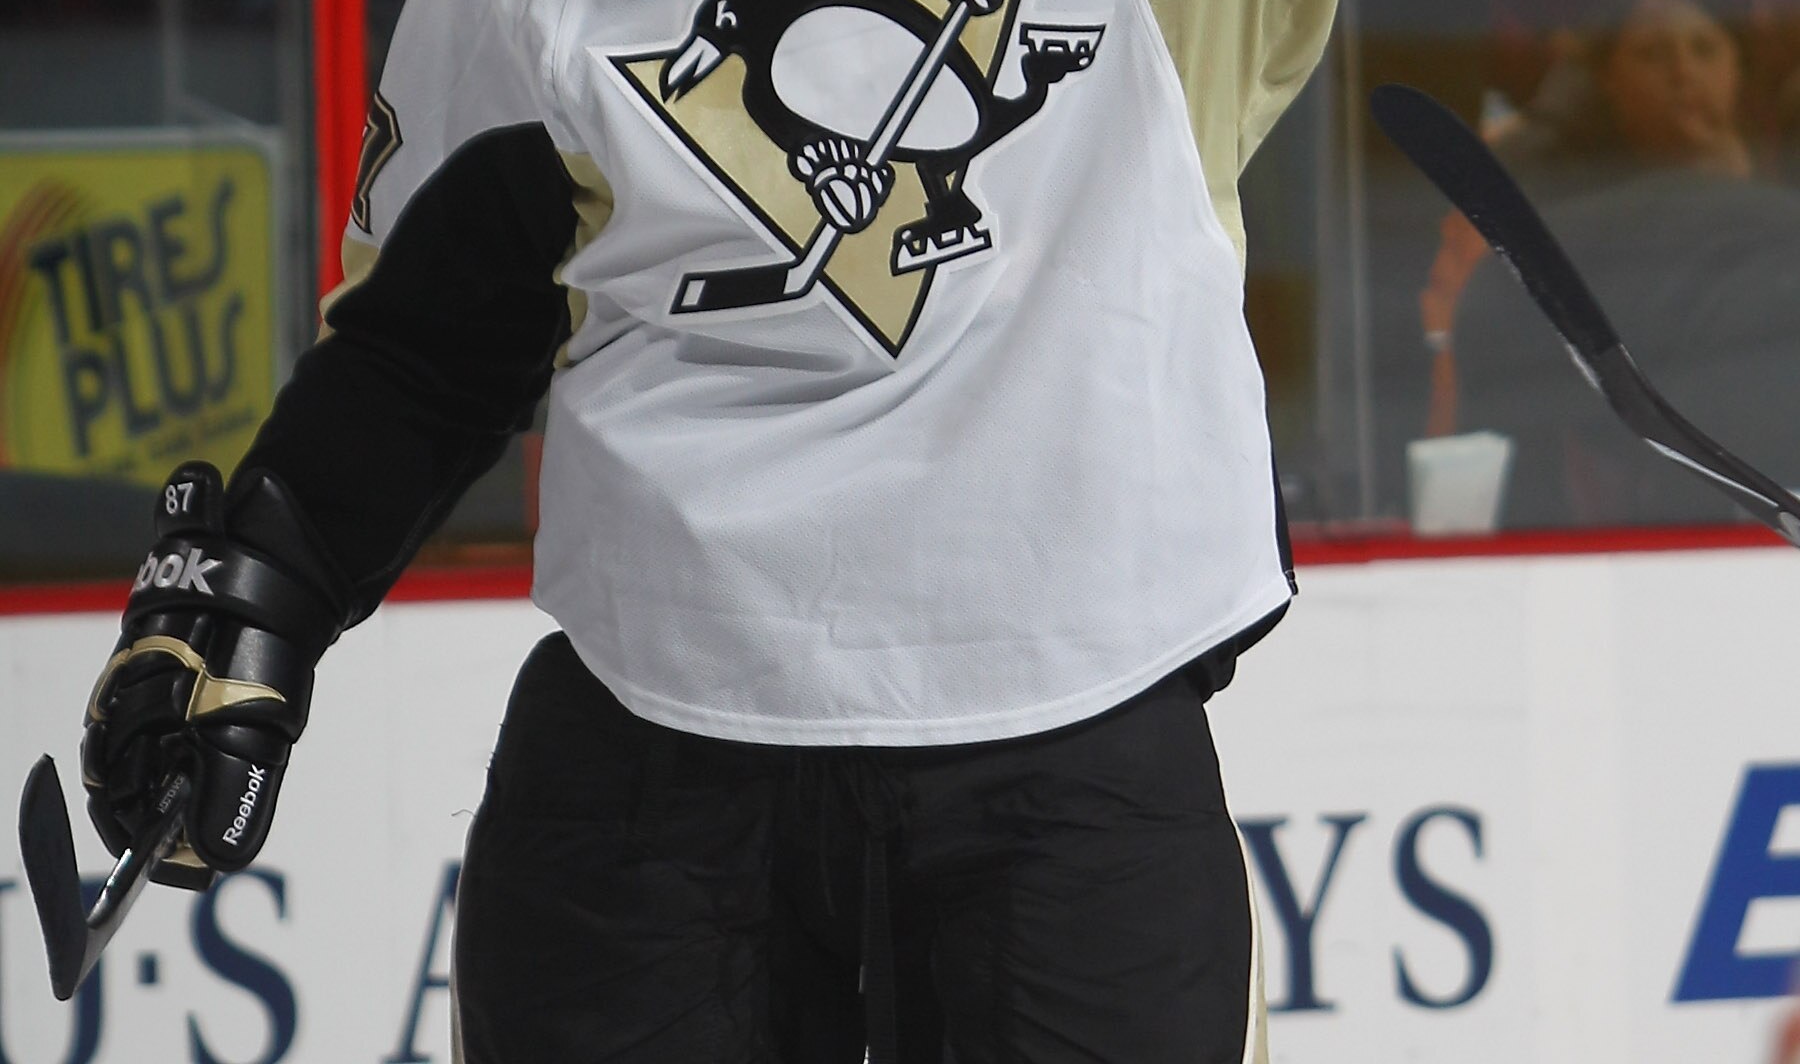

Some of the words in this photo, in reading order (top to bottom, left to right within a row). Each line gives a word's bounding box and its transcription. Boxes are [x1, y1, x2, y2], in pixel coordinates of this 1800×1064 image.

[30, 174, 236, 345] TIRES
[62, 290, 244, 458] PLUS
[165, 481, 194, 515] 87
[222, 764, 265, 845] Reebok
